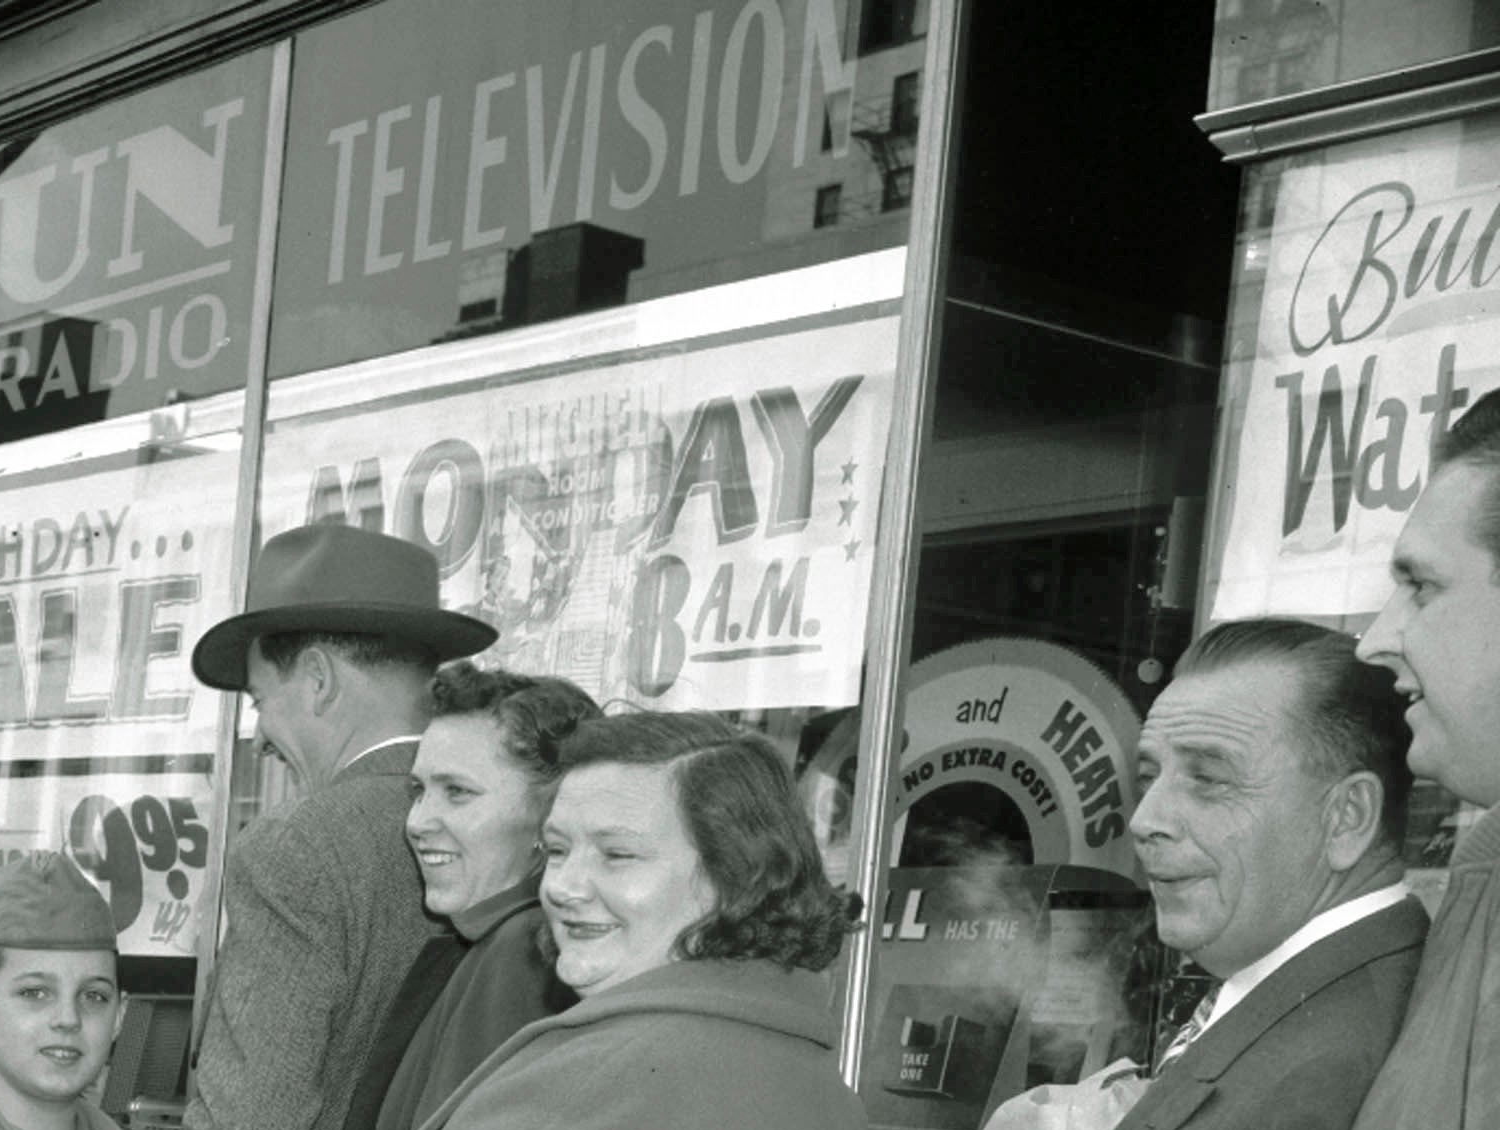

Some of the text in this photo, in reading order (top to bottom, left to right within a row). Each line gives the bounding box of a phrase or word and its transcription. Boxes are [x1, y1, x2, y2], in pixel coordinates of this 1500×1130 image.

[327, 0, 857, 286] TELEVISION
[532, 493, 660, 532] CONDITIOER
[627, 554, 821, 698] 8 A.M.
[955, 686, 1009, 724] and
[902, 762, 935, 793] NO
[941, 748, 1007, 772] EXTRA
[1011, 760, 1059, 819] COST!
[1041, 699, 1126, 849] HEATS
[944, 919, 981, 941] HAS
[985, 919, 1019, 941] THE
[900, 1068, 924, 1081] ONE
[902, 1052, 930, 1067] TAKE
